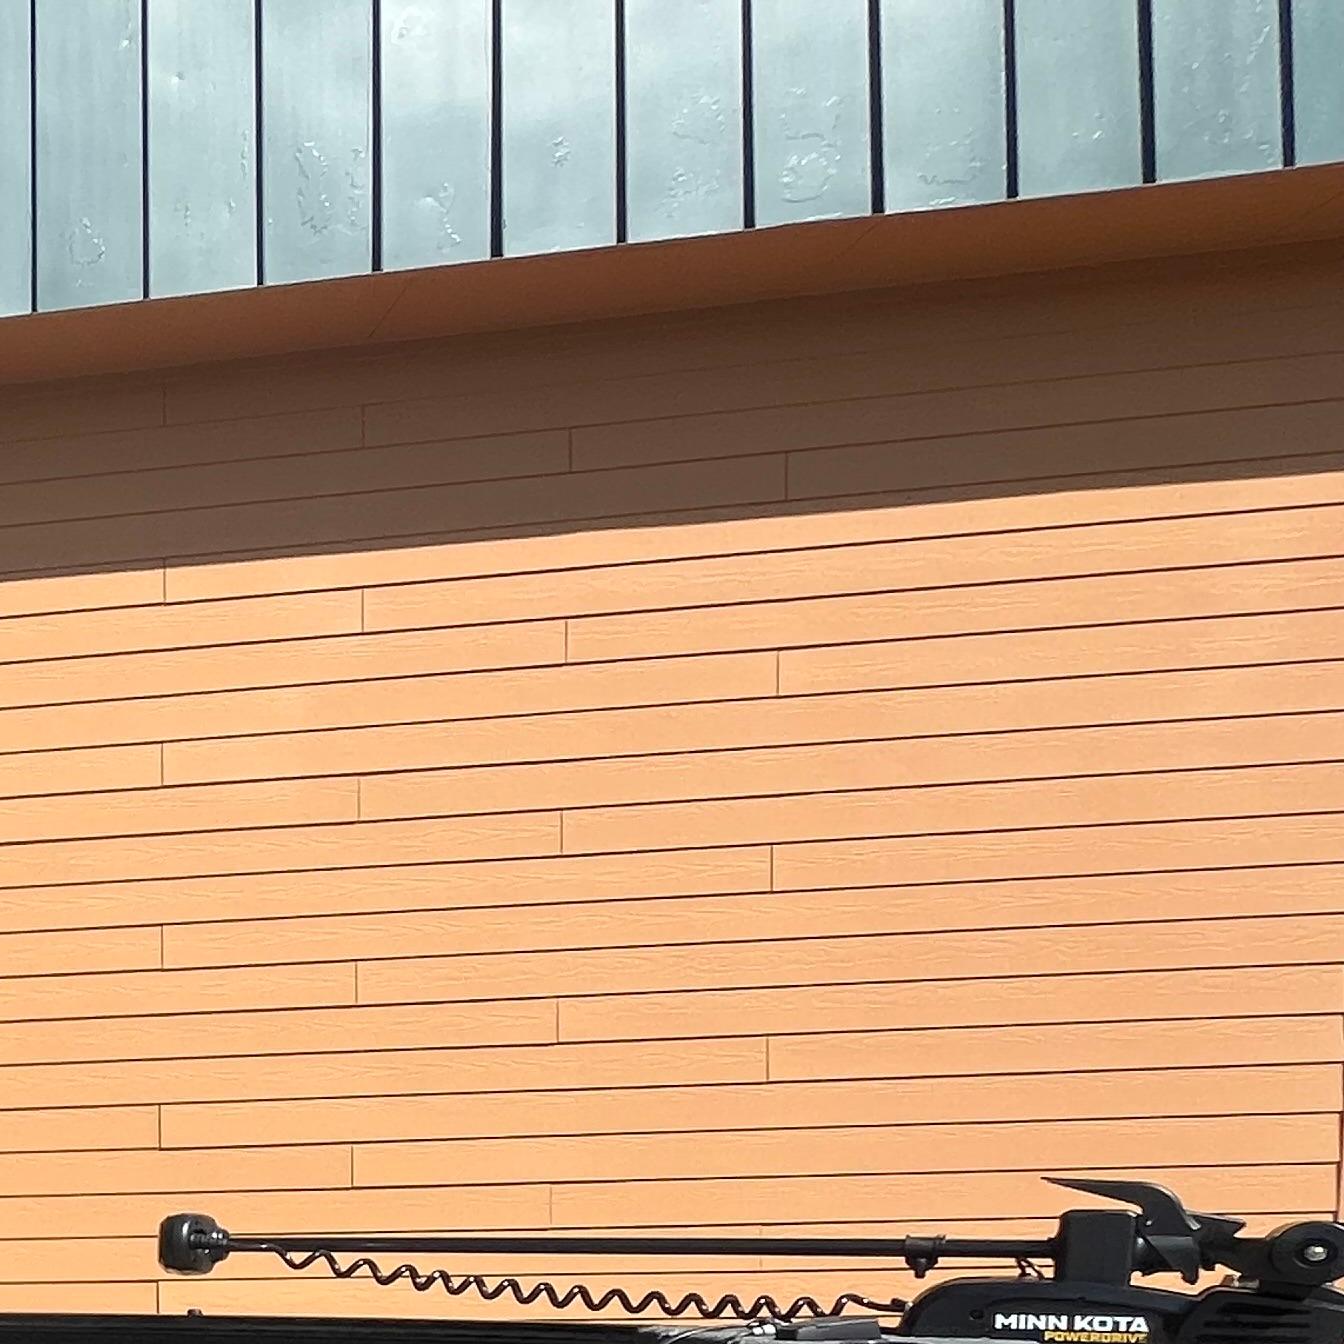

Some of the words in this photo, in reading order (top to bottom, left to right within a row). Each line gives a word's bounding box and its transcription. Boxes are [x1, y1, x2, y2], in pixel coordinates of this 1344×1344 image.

[994, 1312, 1068, 1331] MINN
[1074, 1314, 1150, 1333] KOTA
[1043, 1330, 1148, 1344] POWERDRIVE
